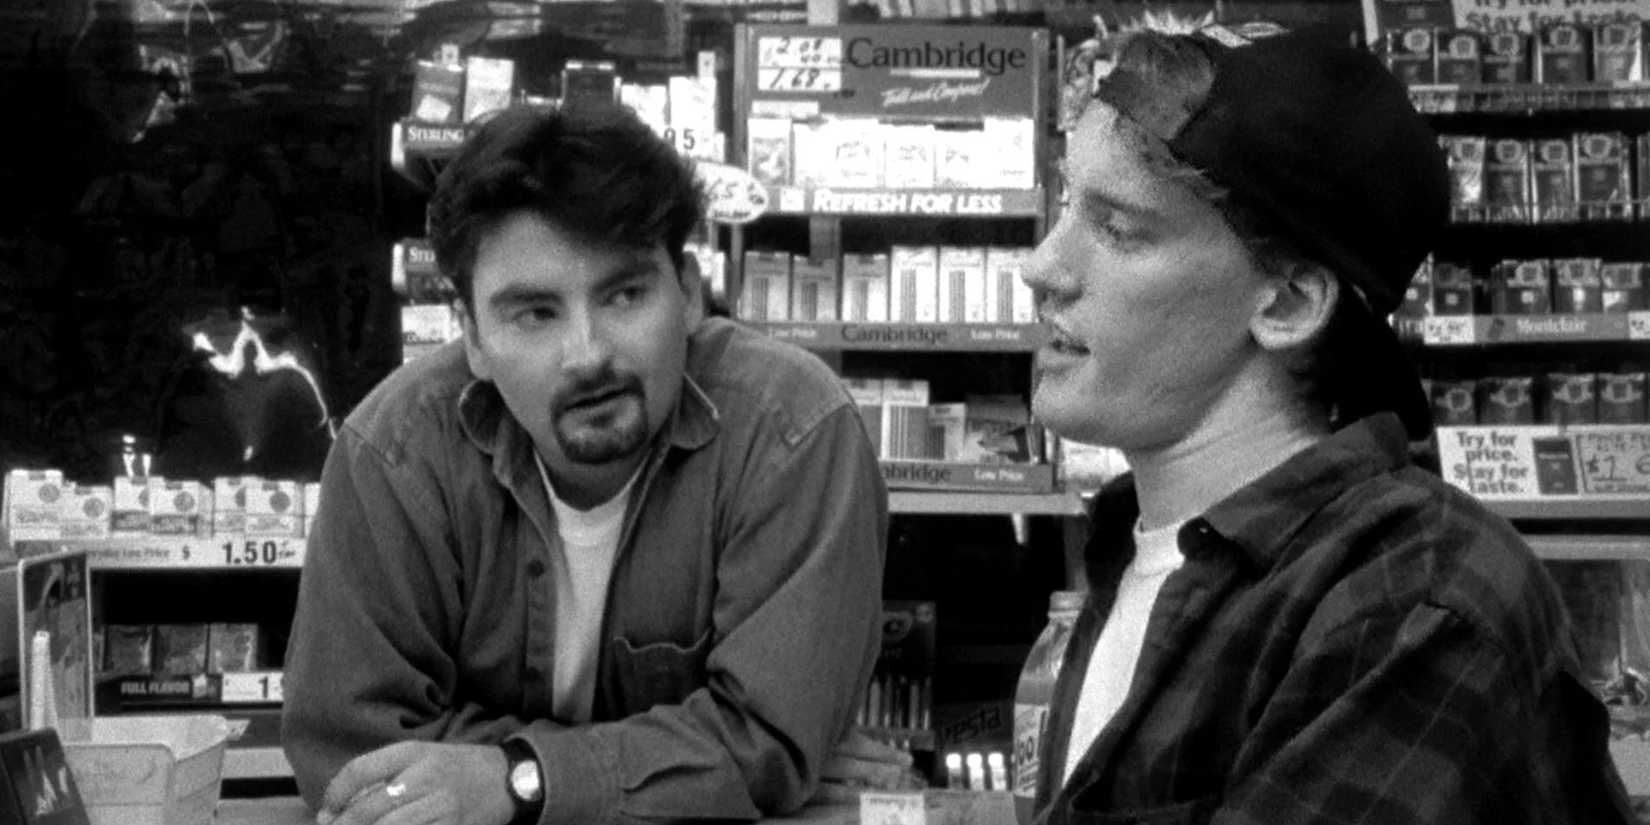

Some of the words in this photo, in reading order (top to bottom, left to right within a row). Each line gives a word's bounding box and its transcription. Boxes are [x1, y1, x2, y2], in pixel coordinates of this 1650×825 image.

[846, 37, 1027, 76] Cambridge
[813, 190, 907, 213] REFRESH
[911, 192, 955, 212] FOR
[956, 193, 1002, 212] LESS
[840, 324, 948, 346] Cambridge
[970, 327, 993, 339] Low
[994, 328, 1021, 339] Price
[1456, 431, 1484, 449] Try
[1491, 431, 1517, 446] for
[1466, 448, 1518, 464] price.
[883, 464, 951, 484] bridge
[974, 468, 996, 481] Low
[998, 468, 1023, 481] Price
[1500, 464, 1528, 479] for
[222, 541, 277, 564] 1.50
[121, 682, 147, 695] FULL
[149, 682, 190, 695] FLAVOR
